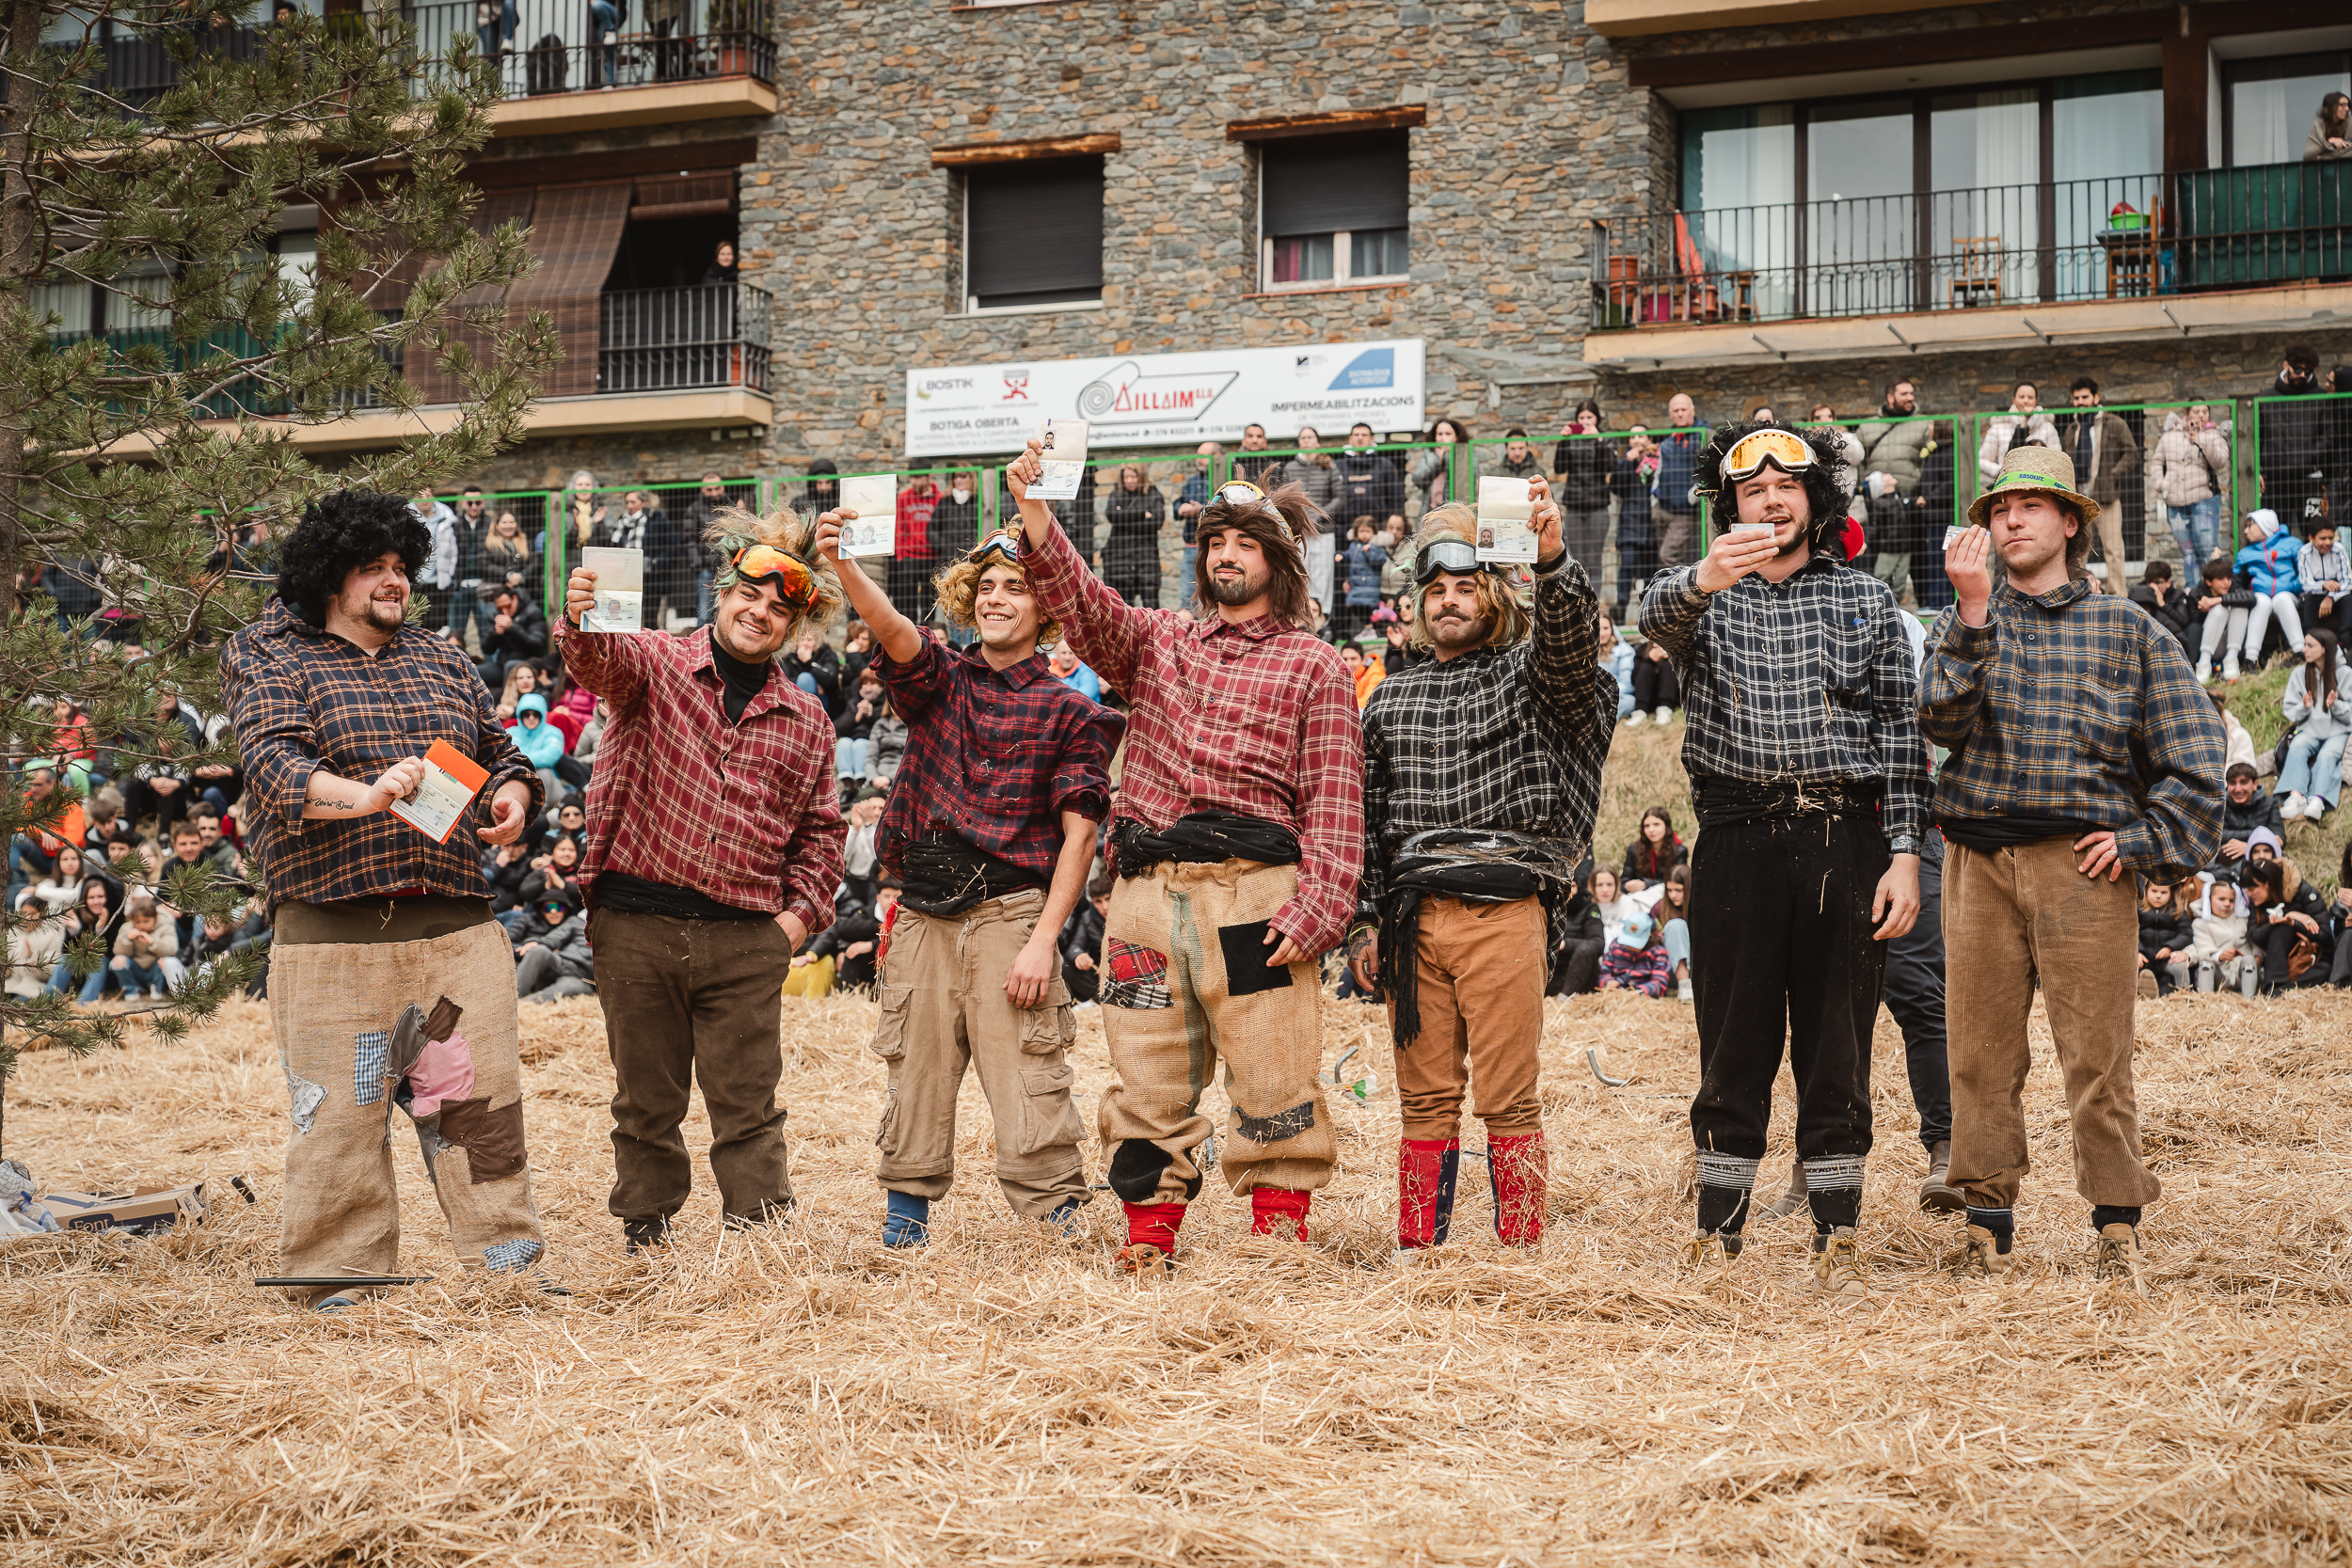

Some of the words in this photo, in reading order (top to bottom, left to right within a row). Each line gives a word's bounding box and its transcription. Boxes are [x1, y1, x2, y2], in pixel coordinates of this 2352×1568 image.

[927, 378, 974, 390] BOSTIK
[1271, 396, 1415, 412] IMPERMEABILITZACIONS
[930, 420, 971, 431] BOTIGA
[975, 417, 1020, 428] OBERTA
